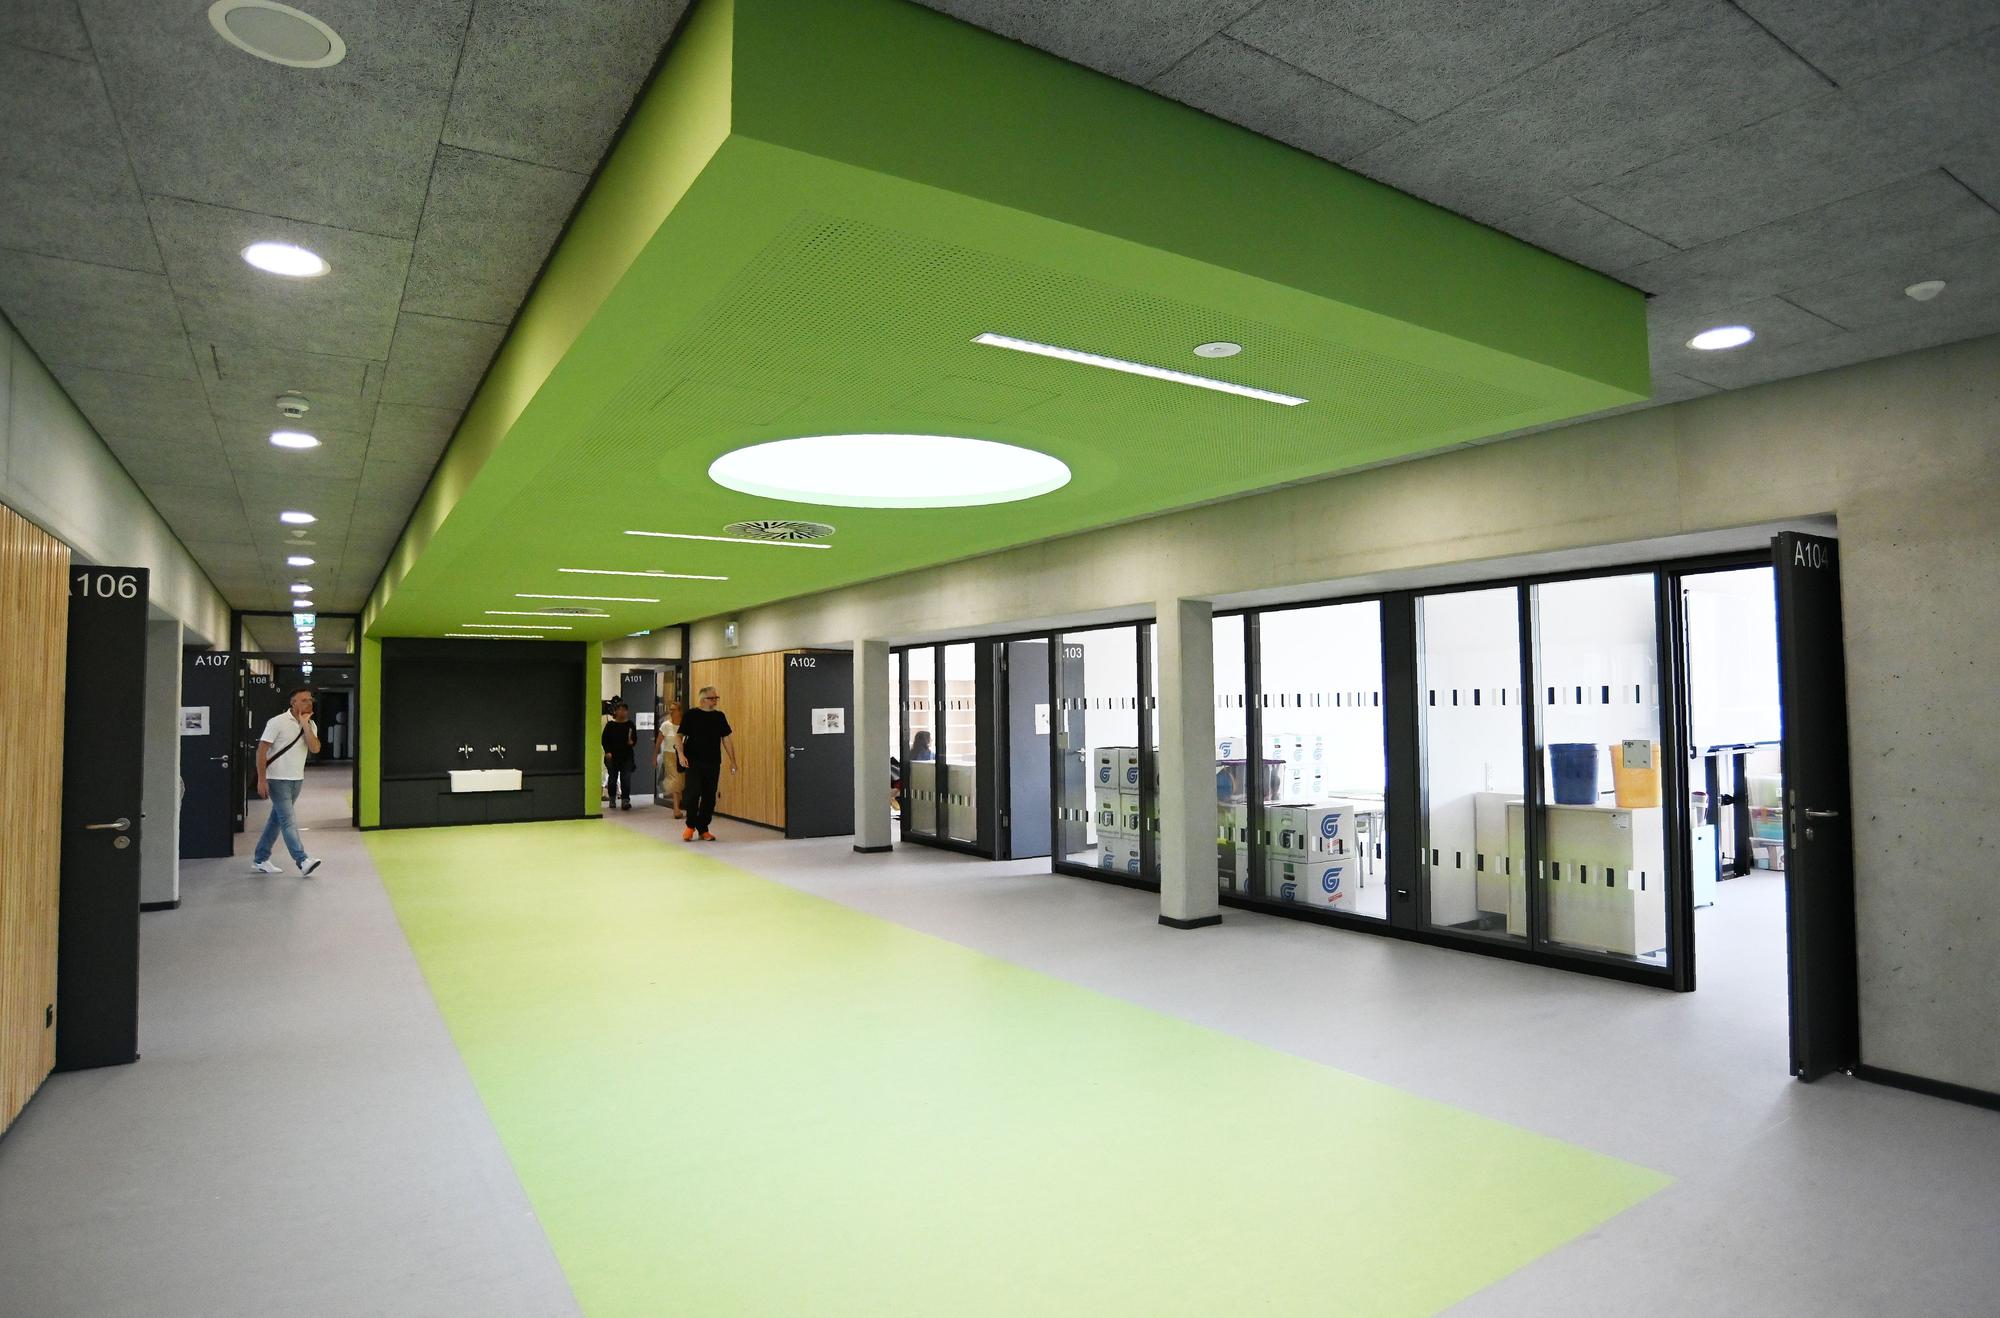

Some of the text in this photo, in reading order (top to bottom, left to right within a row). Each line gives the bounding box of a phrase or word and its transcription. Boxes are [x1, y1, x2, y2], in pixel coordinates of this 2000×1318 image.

[1794, 541, 1828, 569] A104
[69, 573, 138, 599] 106
[1063, 647, 1082, 659] 103
[195, 655, 230, 666] A107
[790, 657, 816, 668] A102
[250, 676, 267, 684] 108
[624, 675, 643, 684] A101
